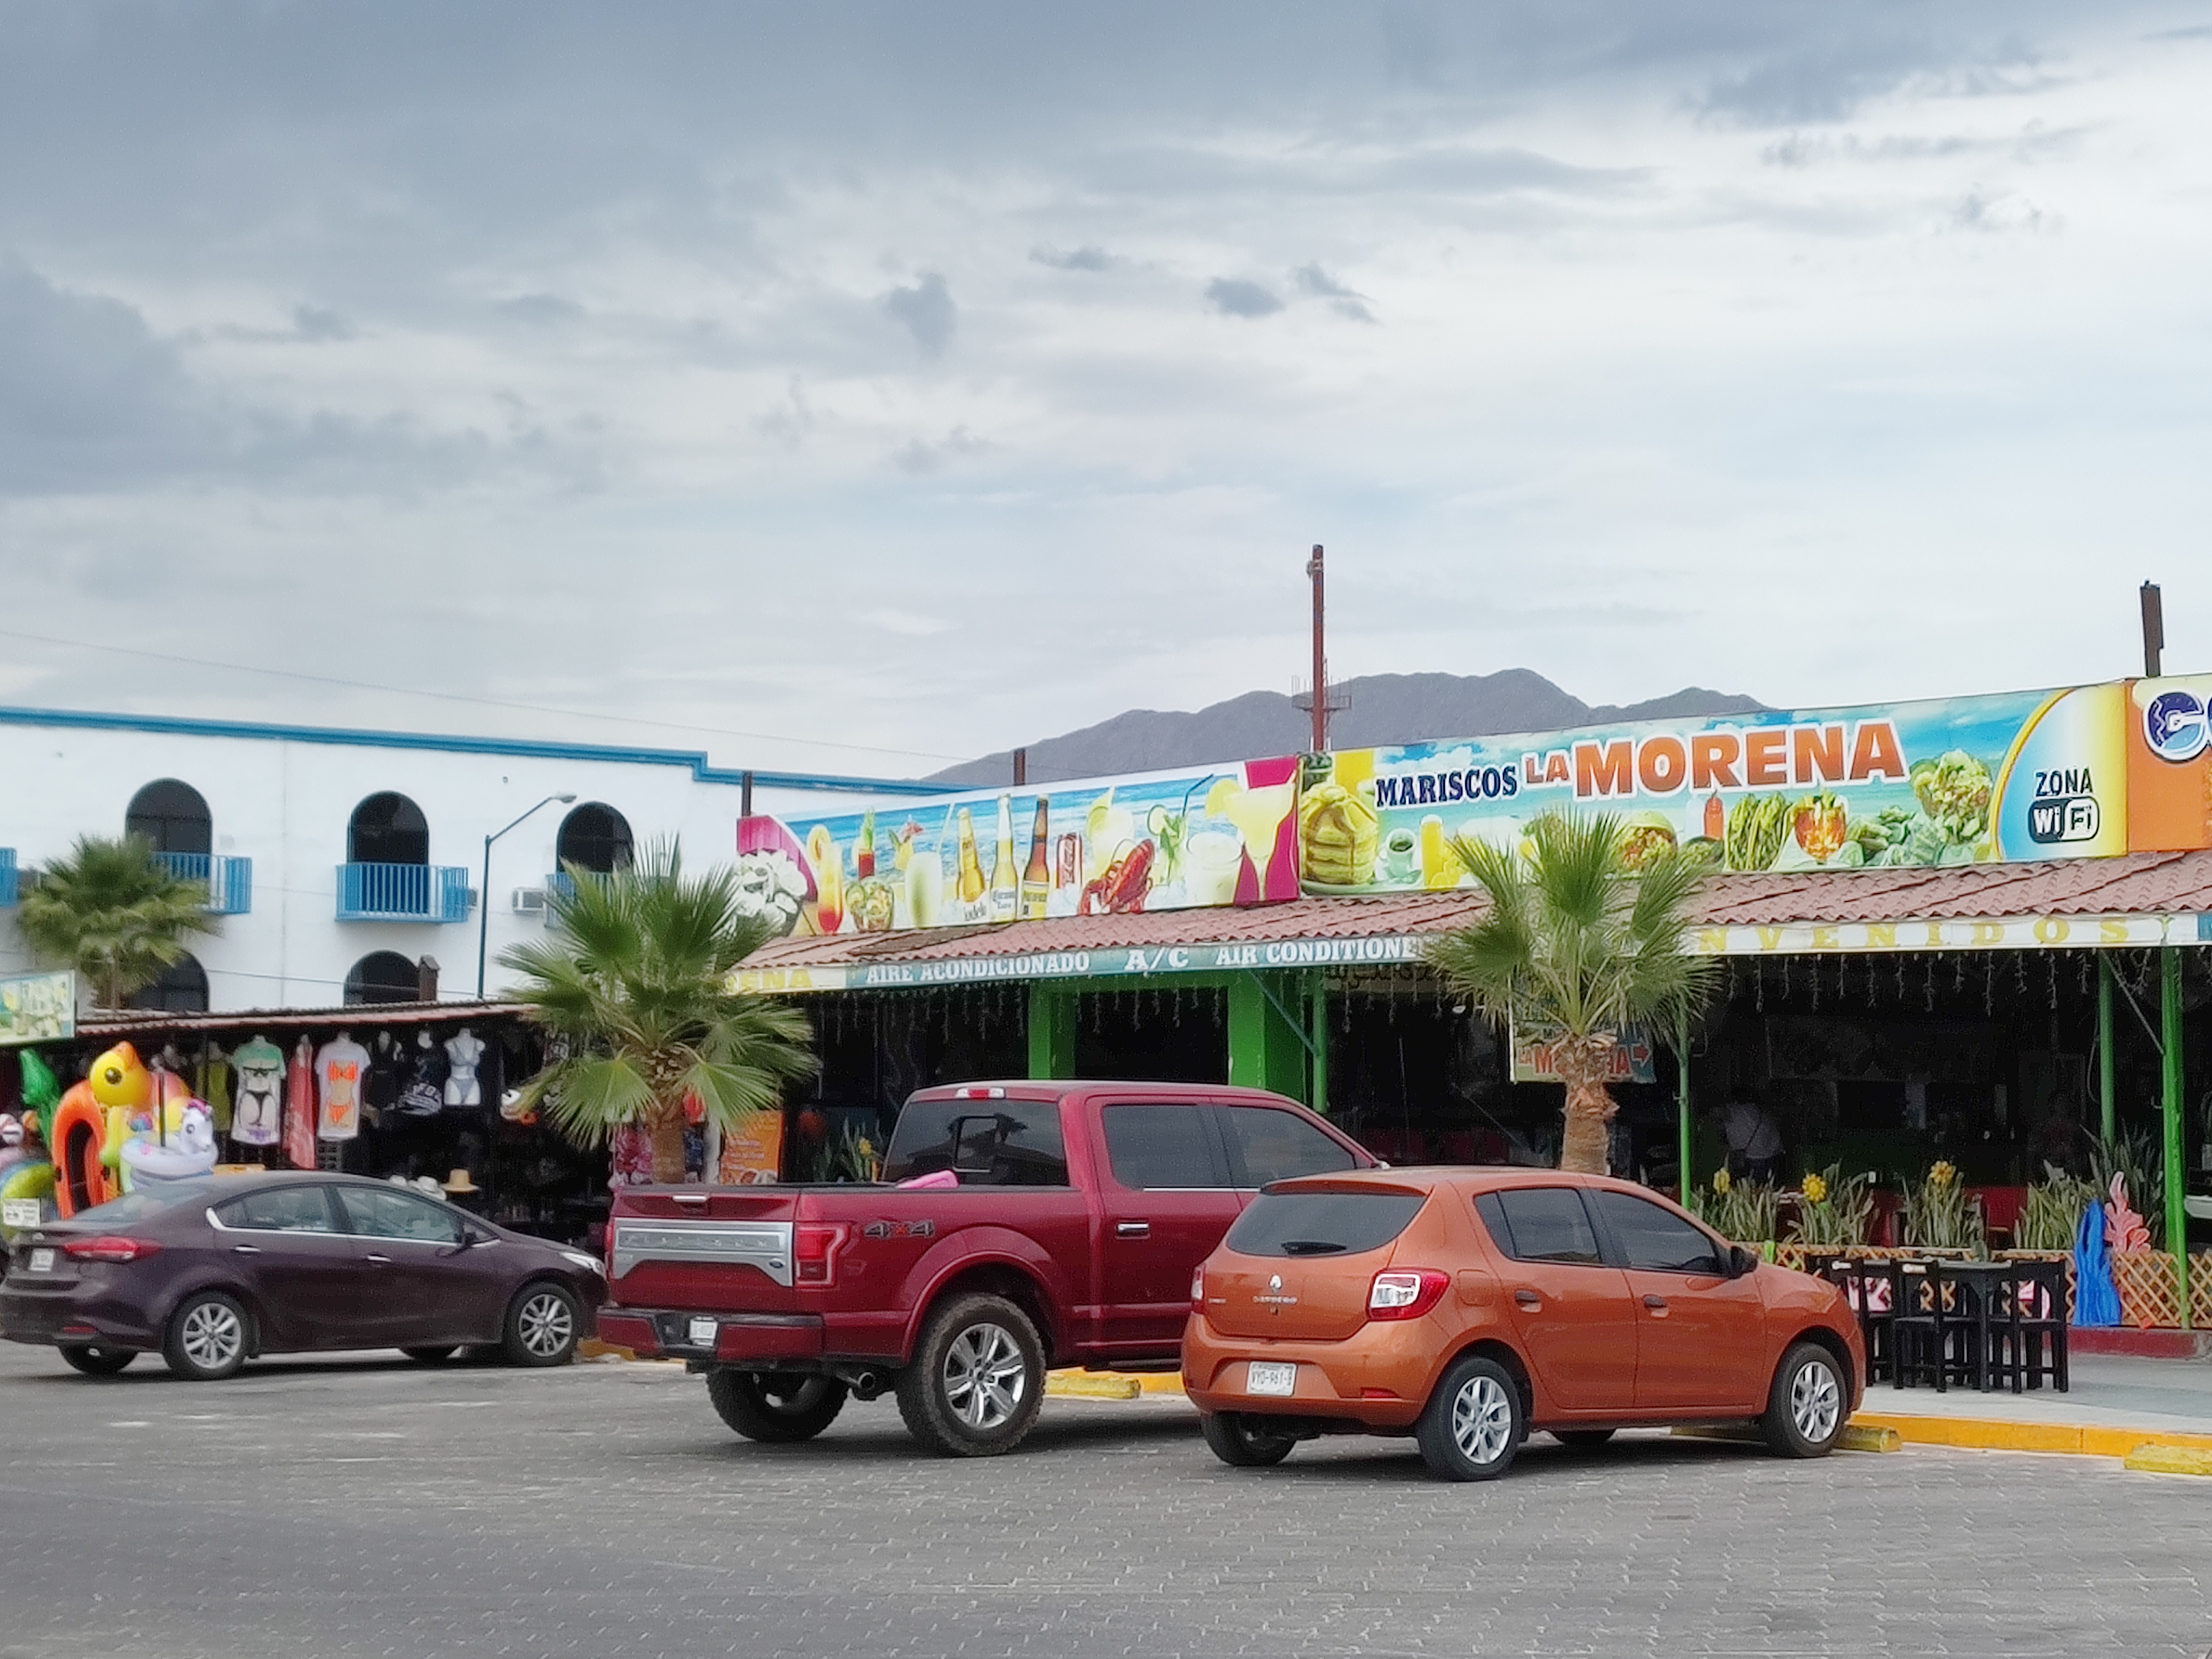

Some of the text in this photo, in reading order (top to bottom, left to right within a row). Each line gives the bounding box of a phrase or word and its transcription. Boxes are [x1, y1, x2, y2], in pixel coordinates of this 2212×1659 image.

[1376, 722, 1906, 807] MARISCOS LA MORENA
[2036, 768, 2093, 796] ZONA
[867, 964, 913, 984] AIRE
[920, 951, 1090, 981] ACONDICIONADO
[1124, 946, 1188, 971] A/C
[1216, 946, 1258, 966] AIR
[1266, 936, 1430, 963] CONDITIONE
